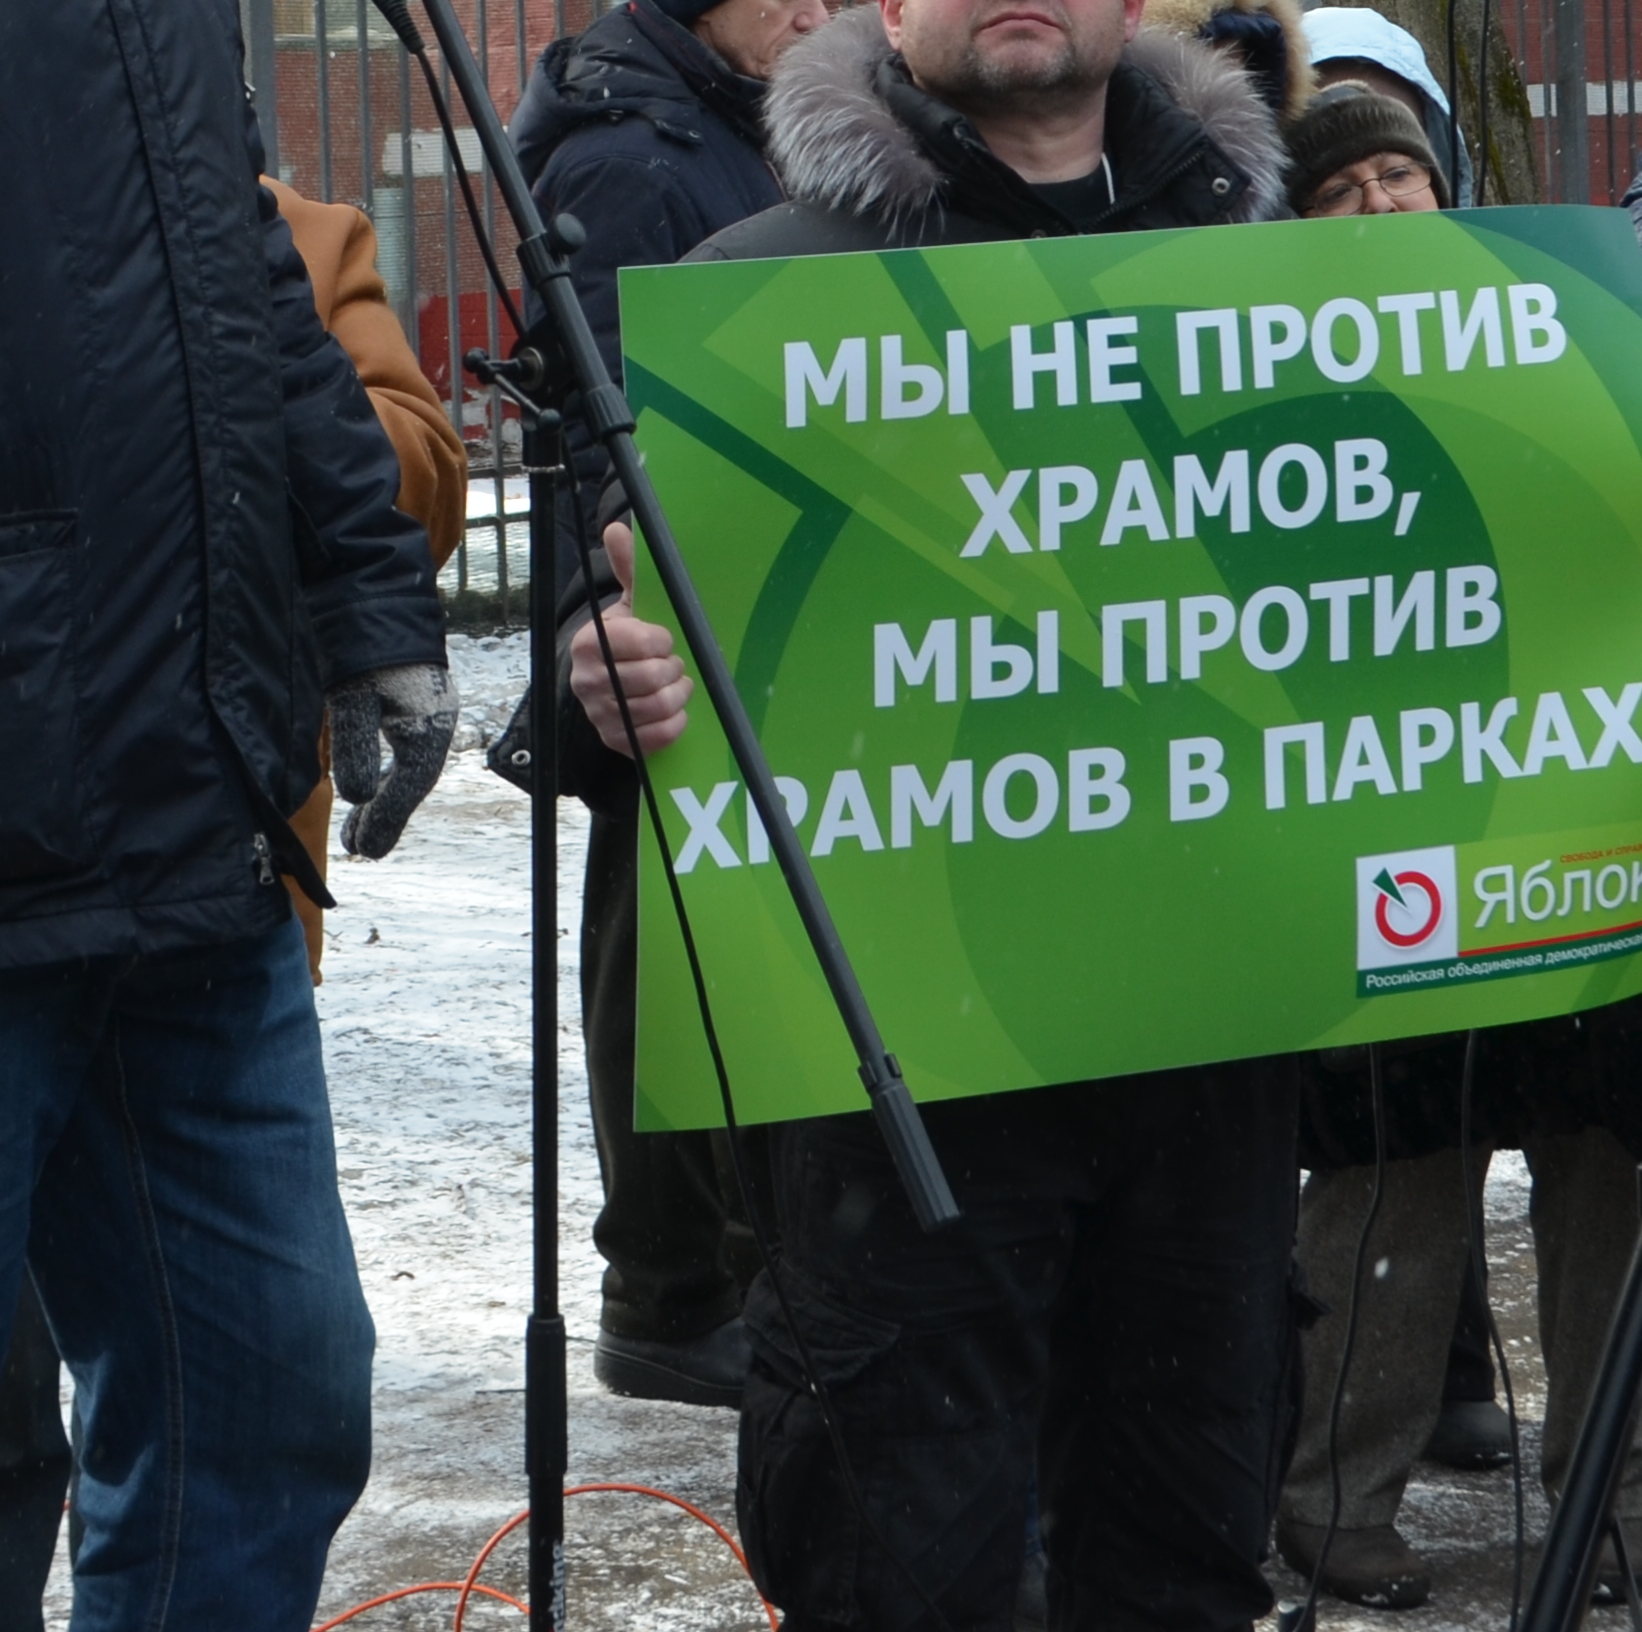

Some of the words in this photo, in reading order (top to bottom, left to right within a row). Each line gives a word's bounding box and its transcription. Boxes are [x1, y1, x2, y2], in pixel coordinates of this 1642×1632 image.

[782, 329, 969, 429] МЫ
[1008, 315, 1143, 411] НЕ
[1174, 282, 1569, 397] ПРОТИВ
[958, 438, 1422, 559] ХРАМОВ,
[873, 610, 1060, 709] МЫ
[1100, 564, 1502, 689] ПРОТИВ
[668, 746, 1132, 876] ХРАМОВ
[1168, 735, 1230, 823] В
[1366, 968, 1445, 988] Российская
[1447, 952, 1543, 977] объединенная
